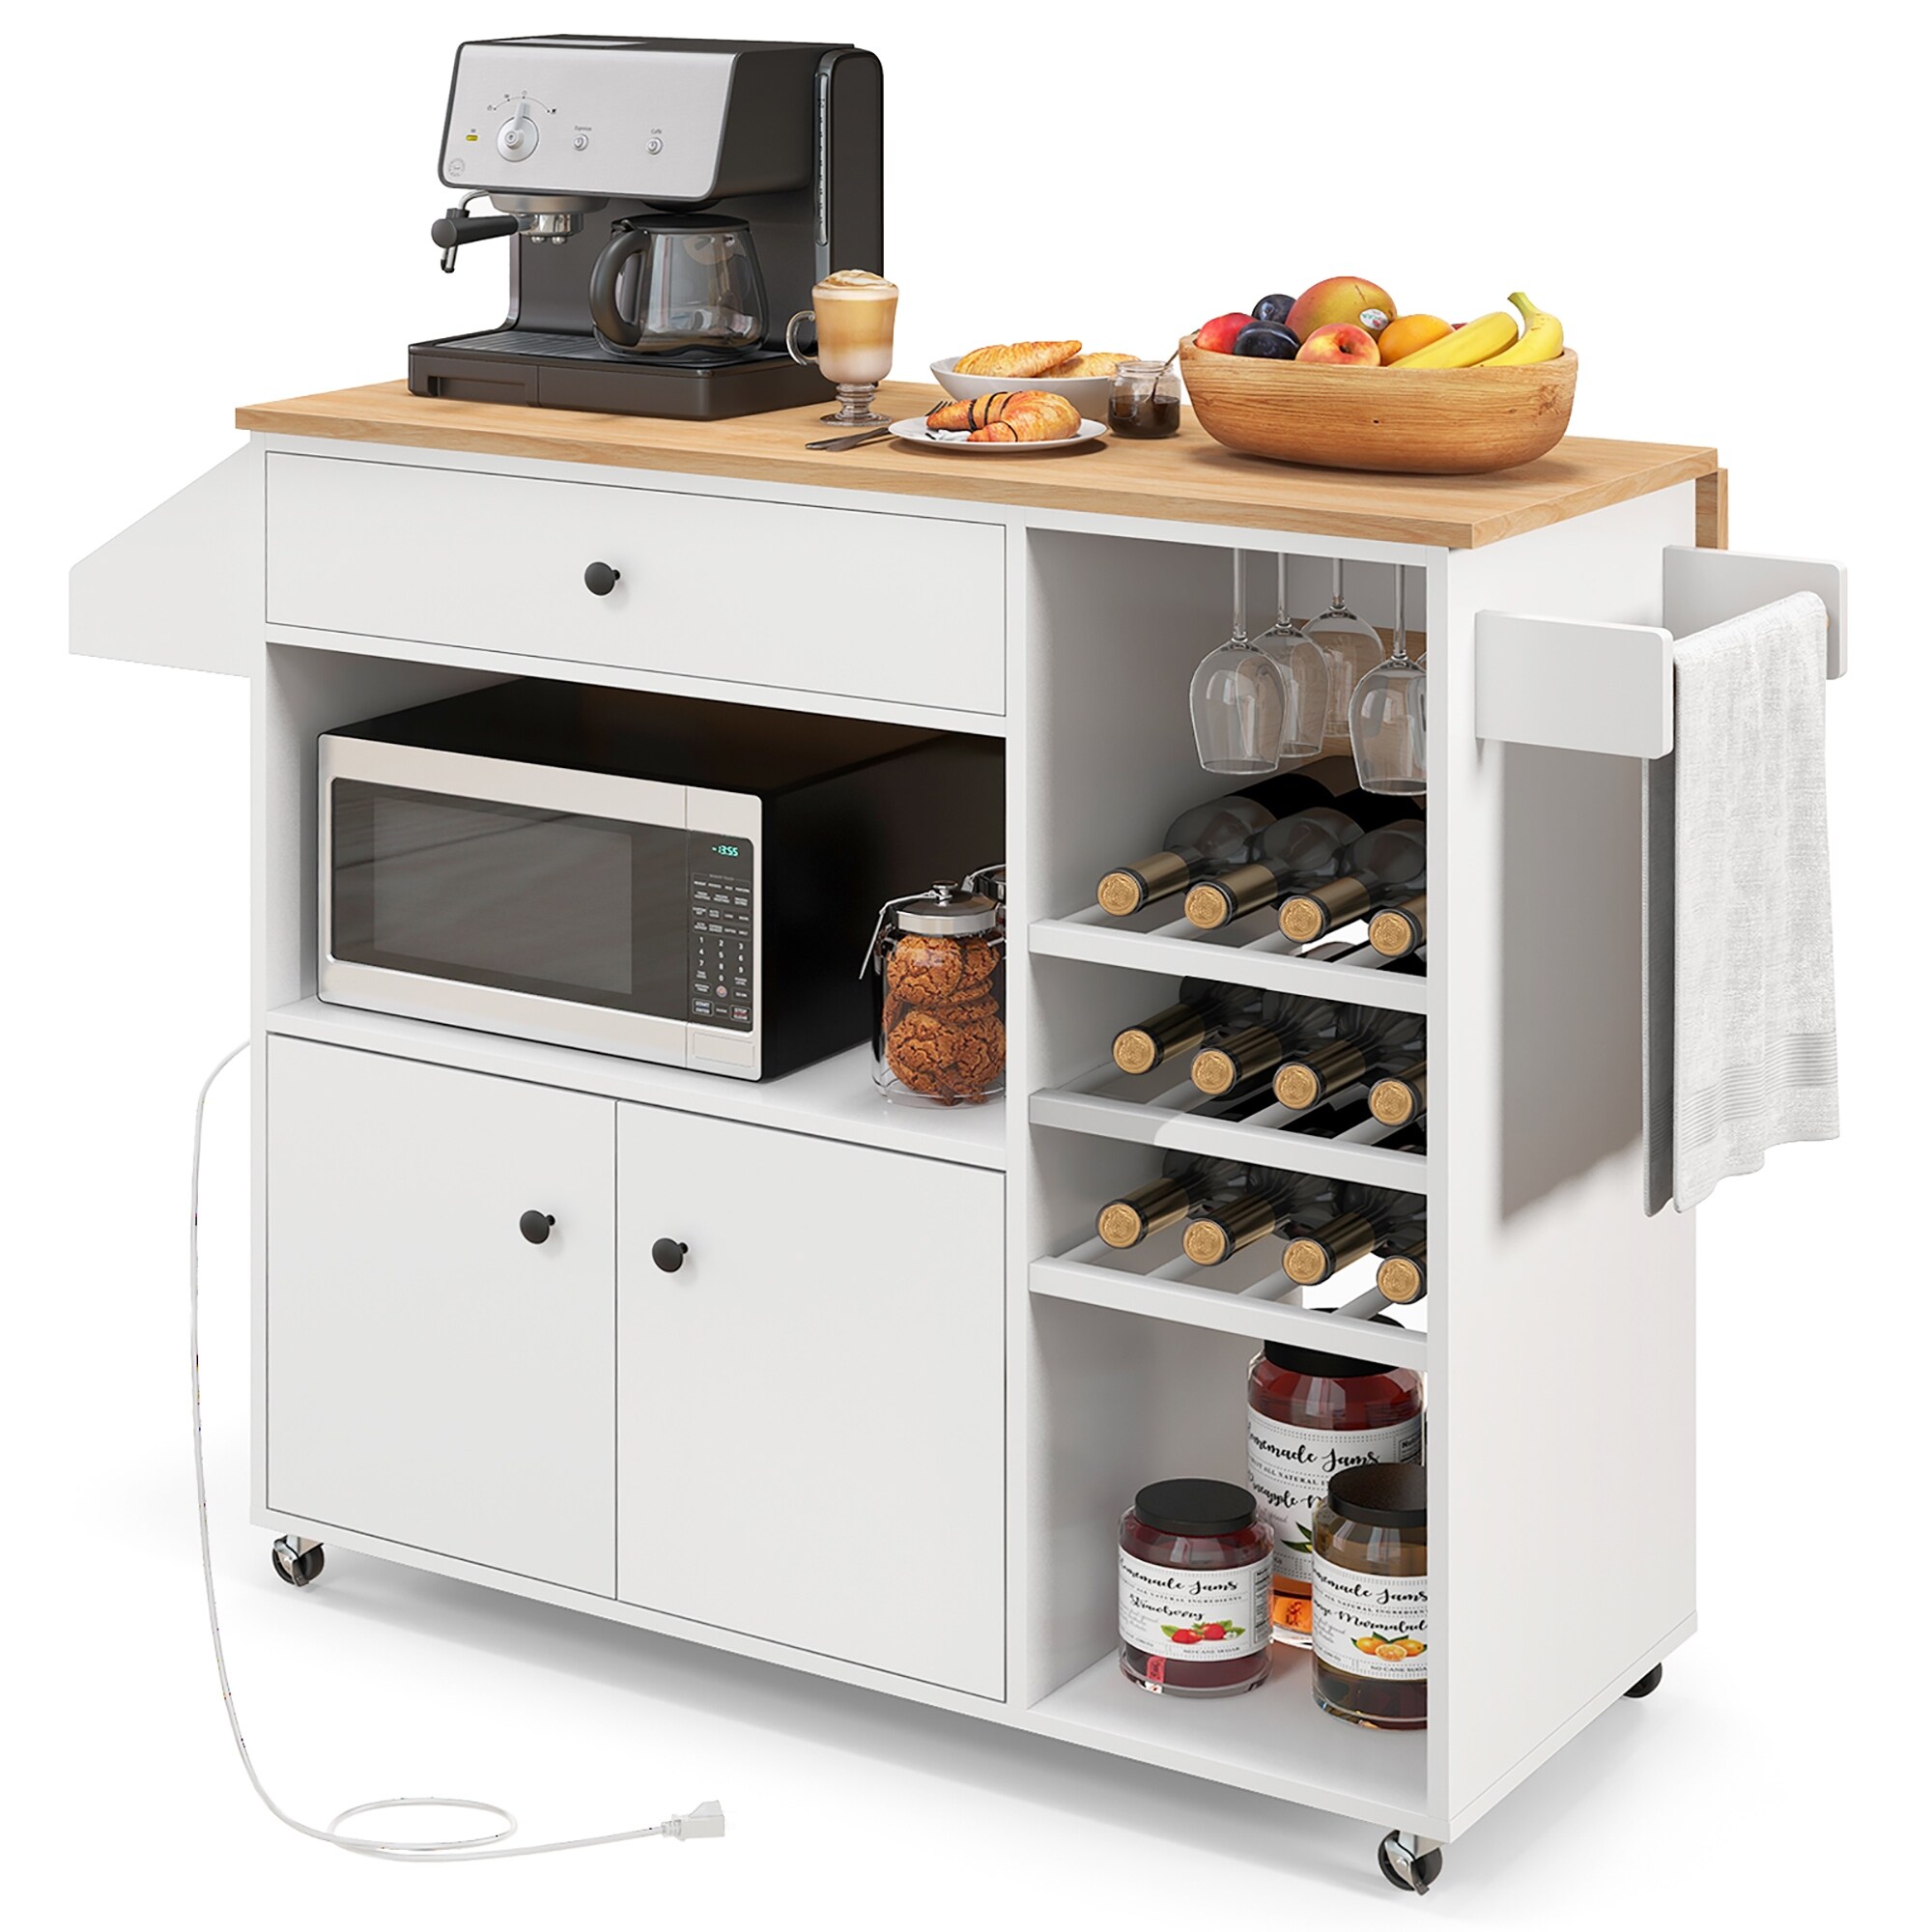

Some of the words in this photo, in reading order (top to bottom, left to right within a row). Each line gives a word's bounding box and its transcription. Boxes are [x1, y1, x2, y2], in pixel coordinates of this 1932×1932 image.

[1188, 1579, 1238, 1596] Jams
[1376, 1588, 1428, 1605] Jams
[1338, 1610, 1428, 1634] Marmalad
